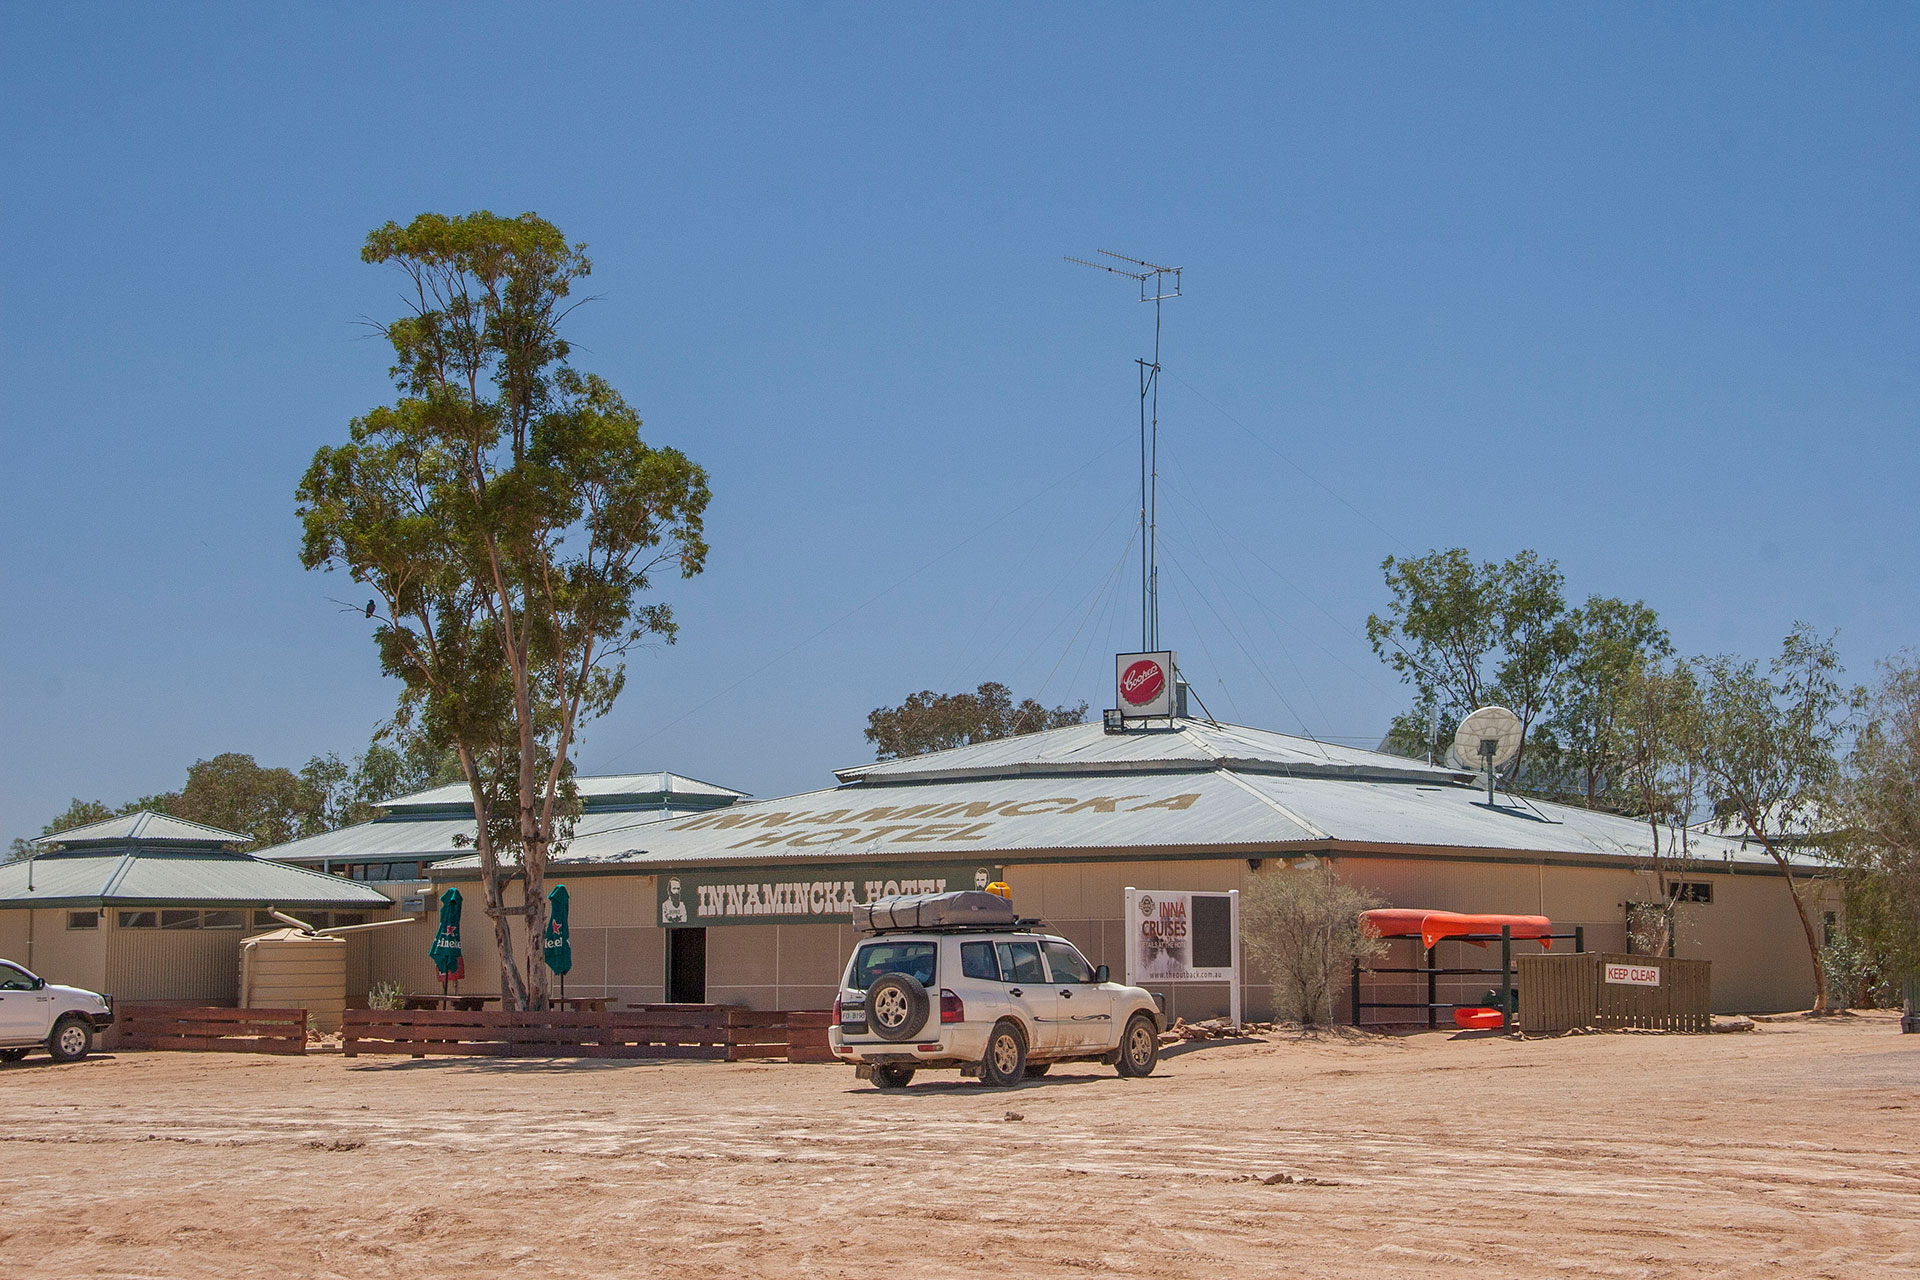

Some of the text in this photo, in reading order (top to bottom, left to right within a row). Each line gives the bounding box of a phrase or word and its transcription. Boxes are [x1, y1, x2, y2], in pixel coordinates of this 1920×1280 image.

[665, 793, 1202, 832] INNAMINCKA
[725, 822, 996, 849] HOTEL
[697, 881, 856, 917] INNAMINCKA
[1159, 902, 1187, 918] INNA
[1141, 920, 1187, 937] CRUISES
[1608, 967, 1656, 982] KEEP CLEAR
